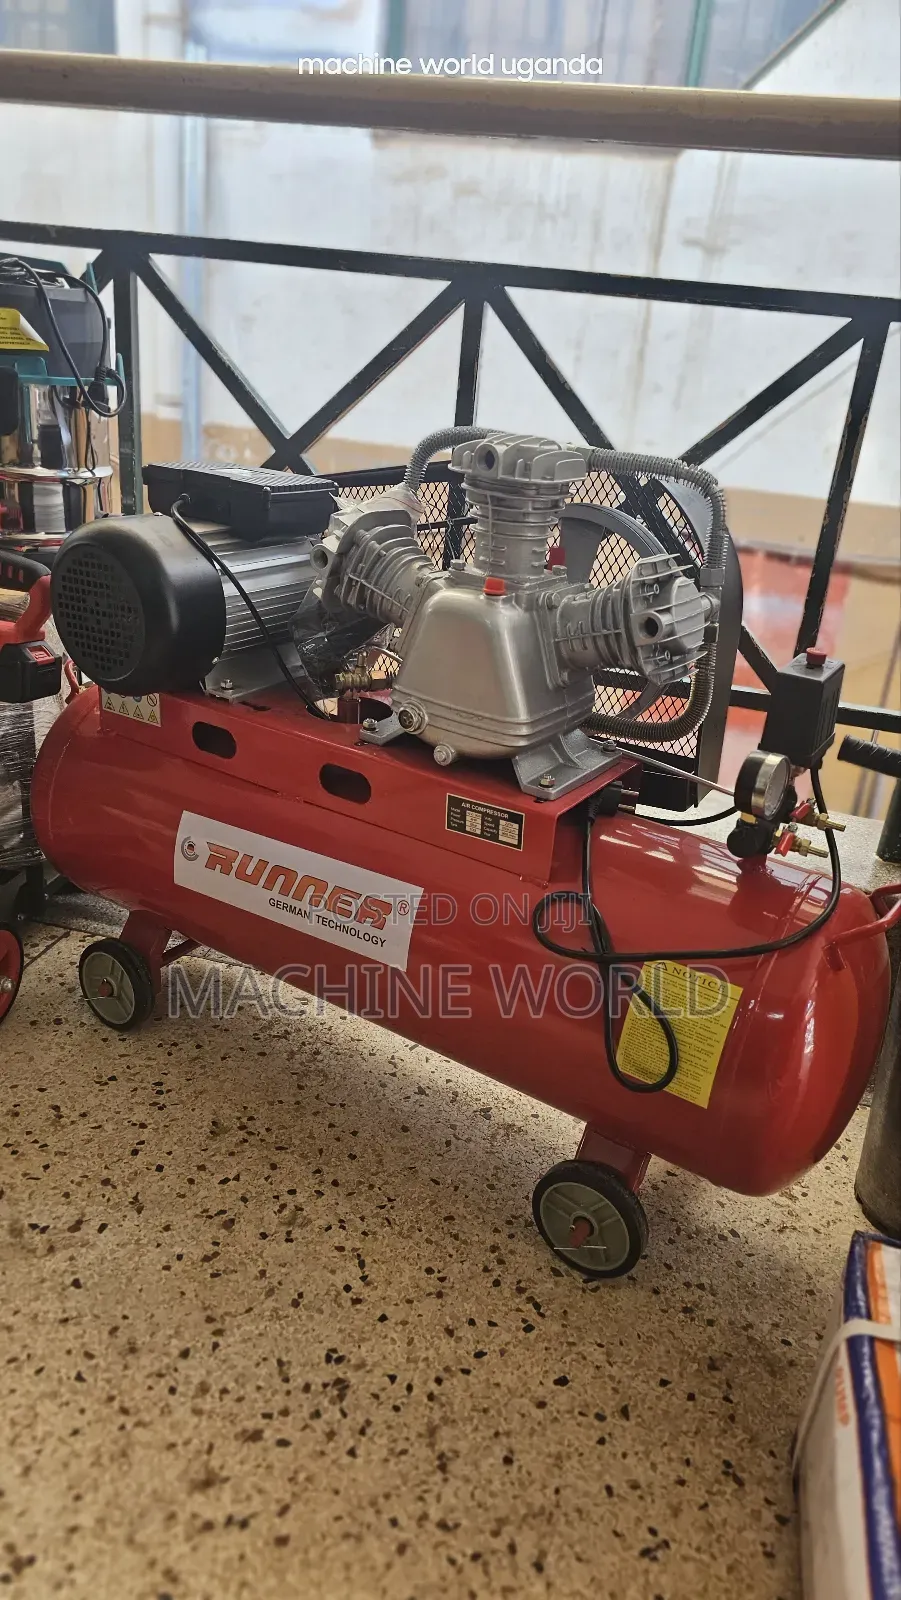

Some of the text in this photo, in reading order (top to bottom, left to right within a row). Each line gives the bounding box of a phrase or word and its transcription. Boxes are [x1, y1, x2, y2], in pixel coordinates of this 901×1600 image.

[471, 805, 509, 819] COMPRESSOR
[204, 841, 393, 931] RUNNER
[268, 897, 387, 948] GERMAN TECHNOLOGY
[672, 967, 726, 993] NOTICE
